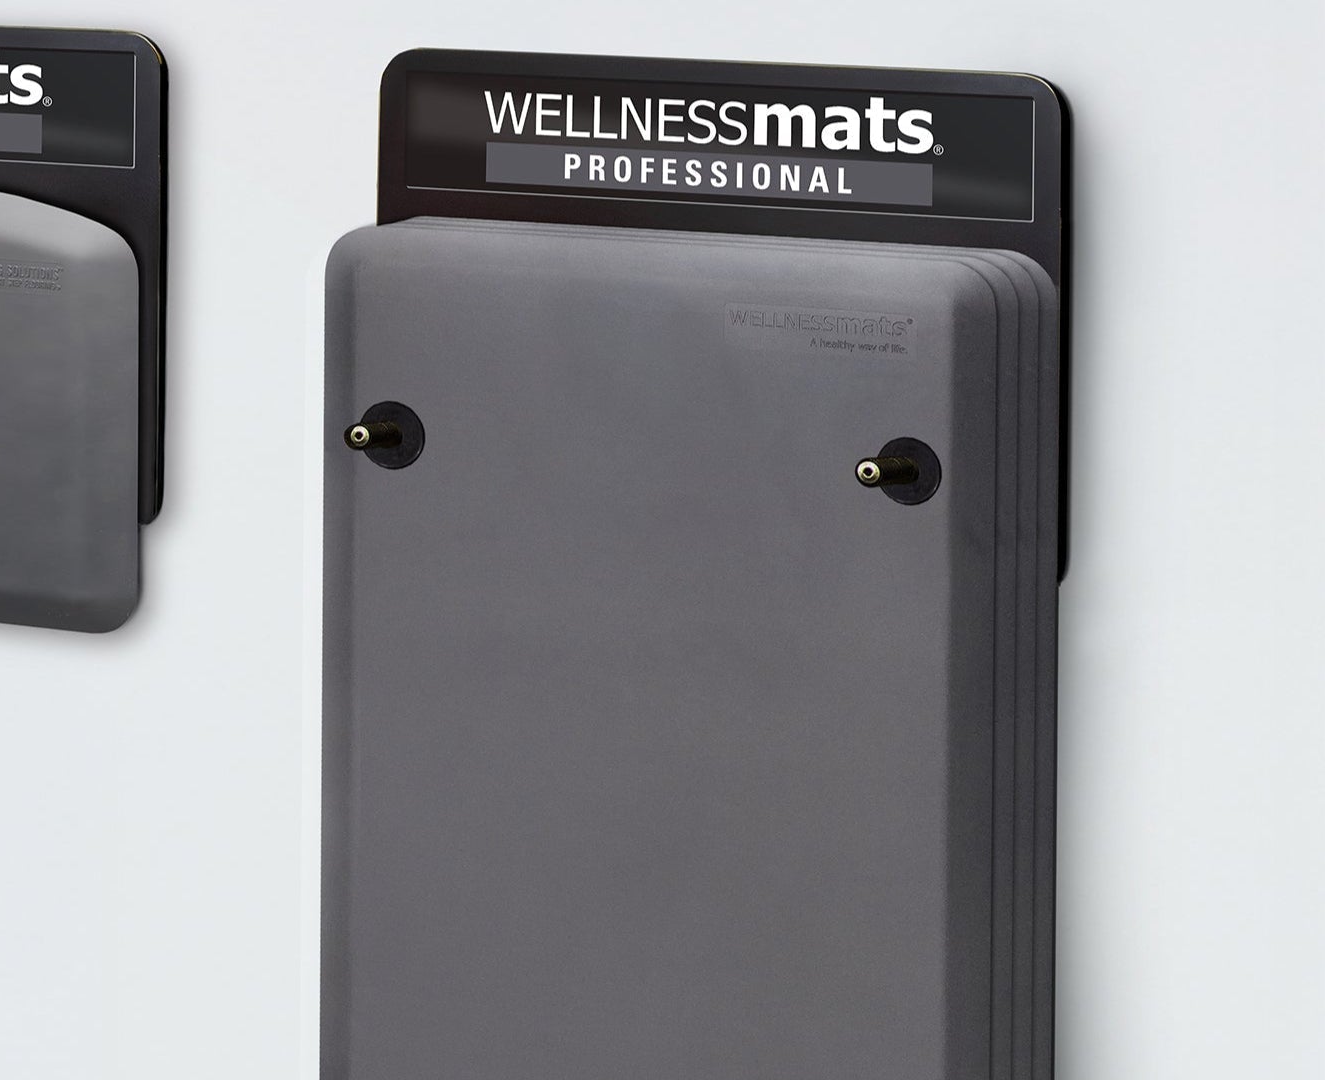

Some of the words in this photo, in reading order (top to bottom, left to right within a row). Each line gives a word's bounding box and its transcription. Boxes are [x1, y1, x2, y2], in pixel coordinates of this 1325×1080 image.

[564, 153, 852, 195] PROFESSIONAL
[809, 337, 817, 348] A
[819, 338, 855, 353] healthy
[857, 342, 878, 354] way
[878, 342, 890, 354] of
